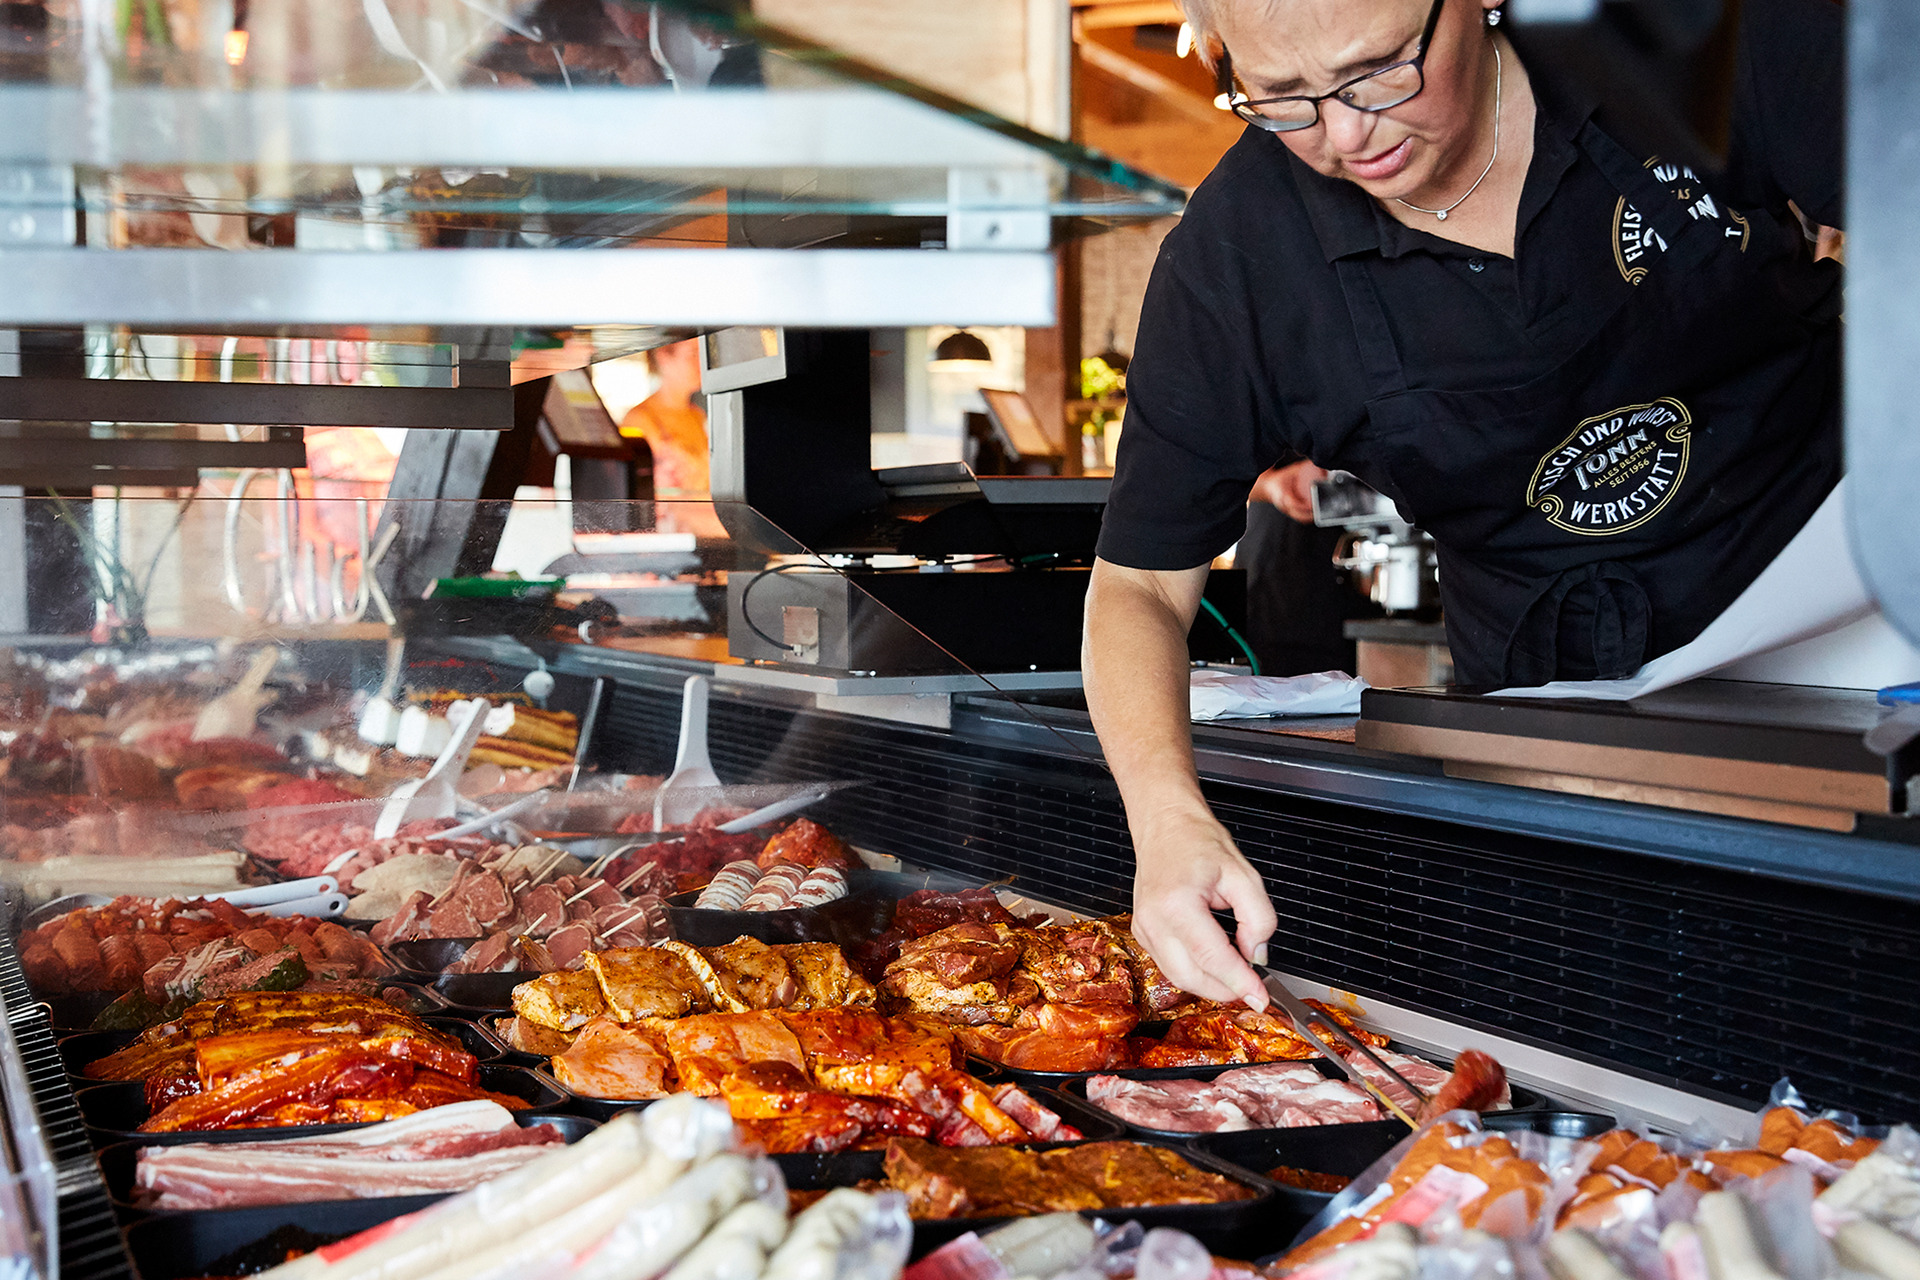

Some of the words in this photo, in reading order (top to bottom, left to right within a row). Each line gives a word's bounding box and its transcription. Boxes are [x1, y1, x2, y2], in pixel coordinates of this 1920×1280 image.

[1621, 203, 1644, 263] FLEIS
[1652, 163, 1679, 184] ND
[1578, 416, 1624, 447] UND
[1628, 406, 1678, 428] WURST
[1569, 448, 1679, 525] WERKSTATT
[1593, 466, 1620, 489] ALLES
[1619, 440, 1658, 469] BESTENS
[1609, 471, 1630, 488] SEIT
[1628, 457, 1651, 475] 1956
